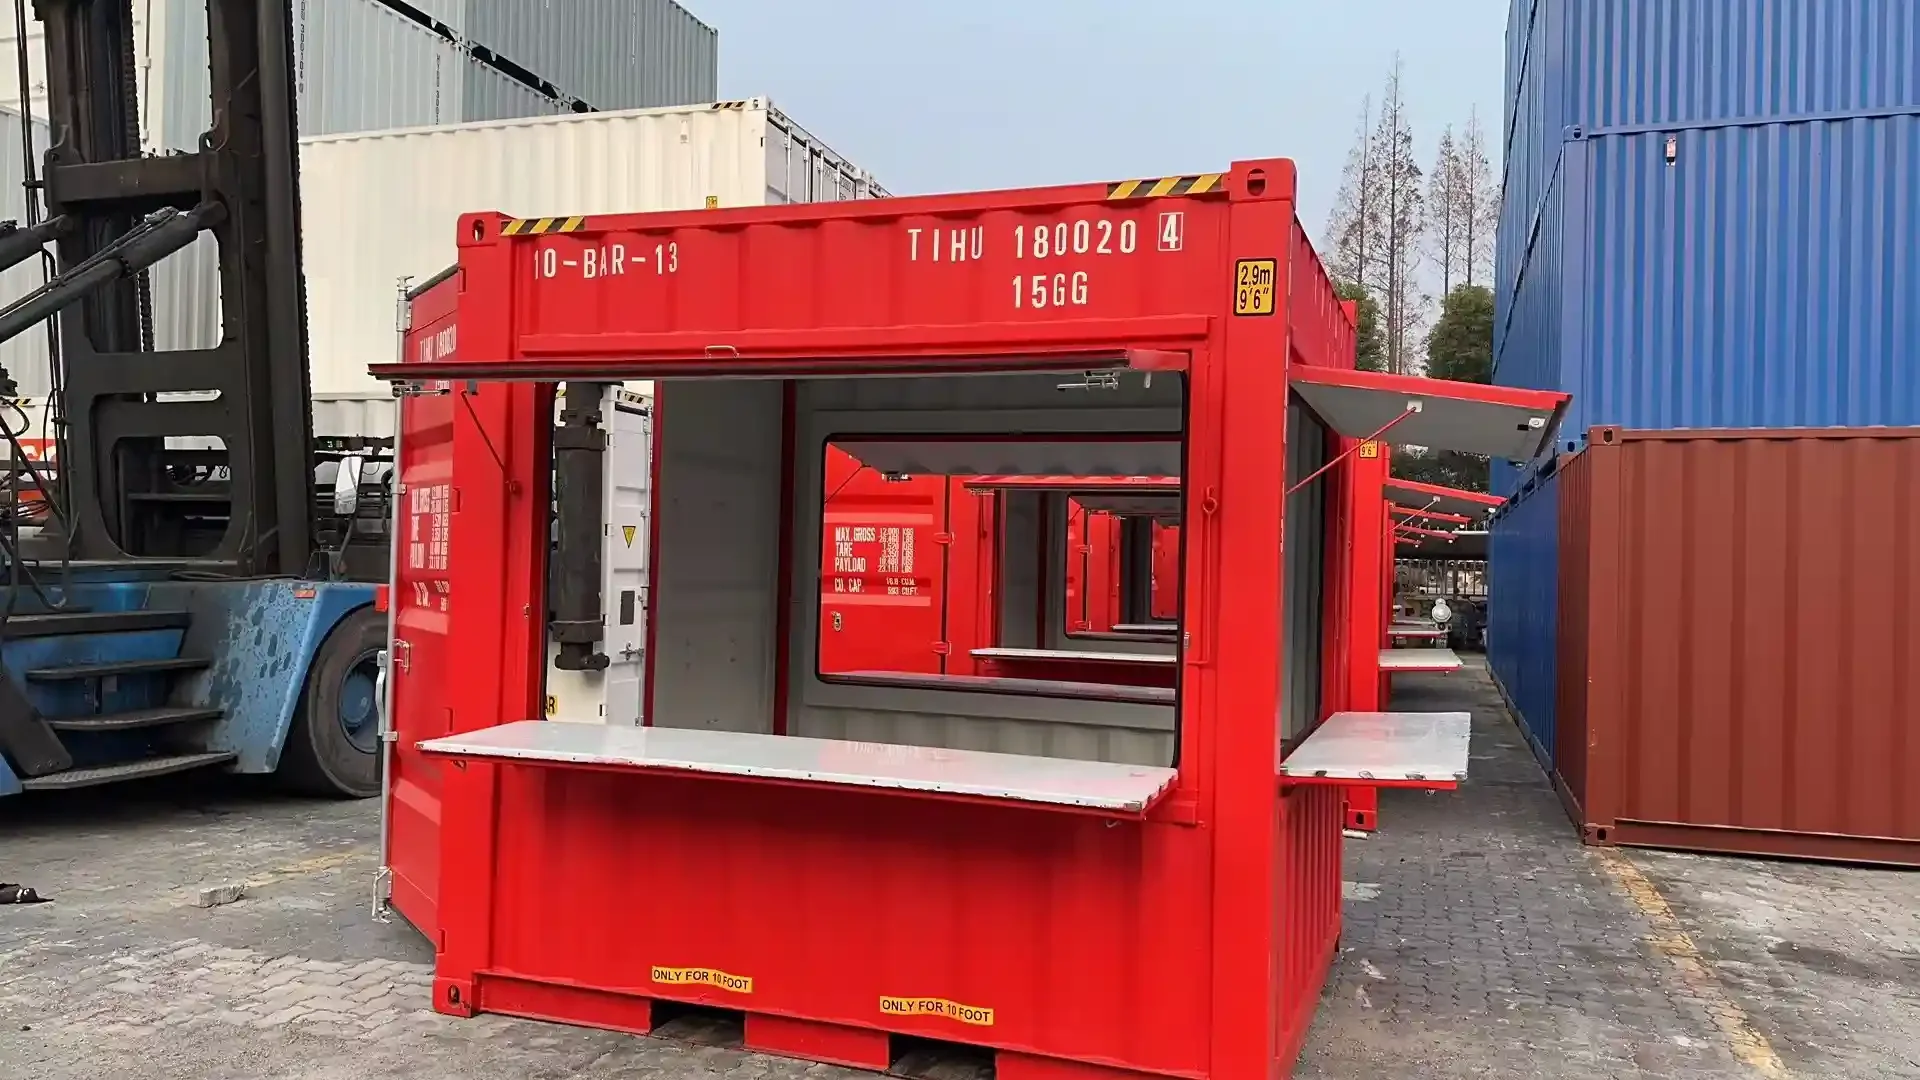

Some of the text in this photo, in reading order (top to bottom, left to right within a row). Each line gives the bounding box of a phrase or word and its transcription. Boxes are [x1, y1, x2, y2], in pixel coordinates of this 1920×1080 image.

[907, 213, 1179, 262] TIHU 180020 4
[534, 241, 678, 280] 10-BAR-13
[1013, 271, 1088, 308] 15GG
[836, 541, 853, 556] TARE
[835, 557, 866, 573] PAYLOAD
[654, 969, 748, 989] ONLY FOR 10 FOOT
[882, 999, 990, 1022] ONLY FOR 10 FOOT
